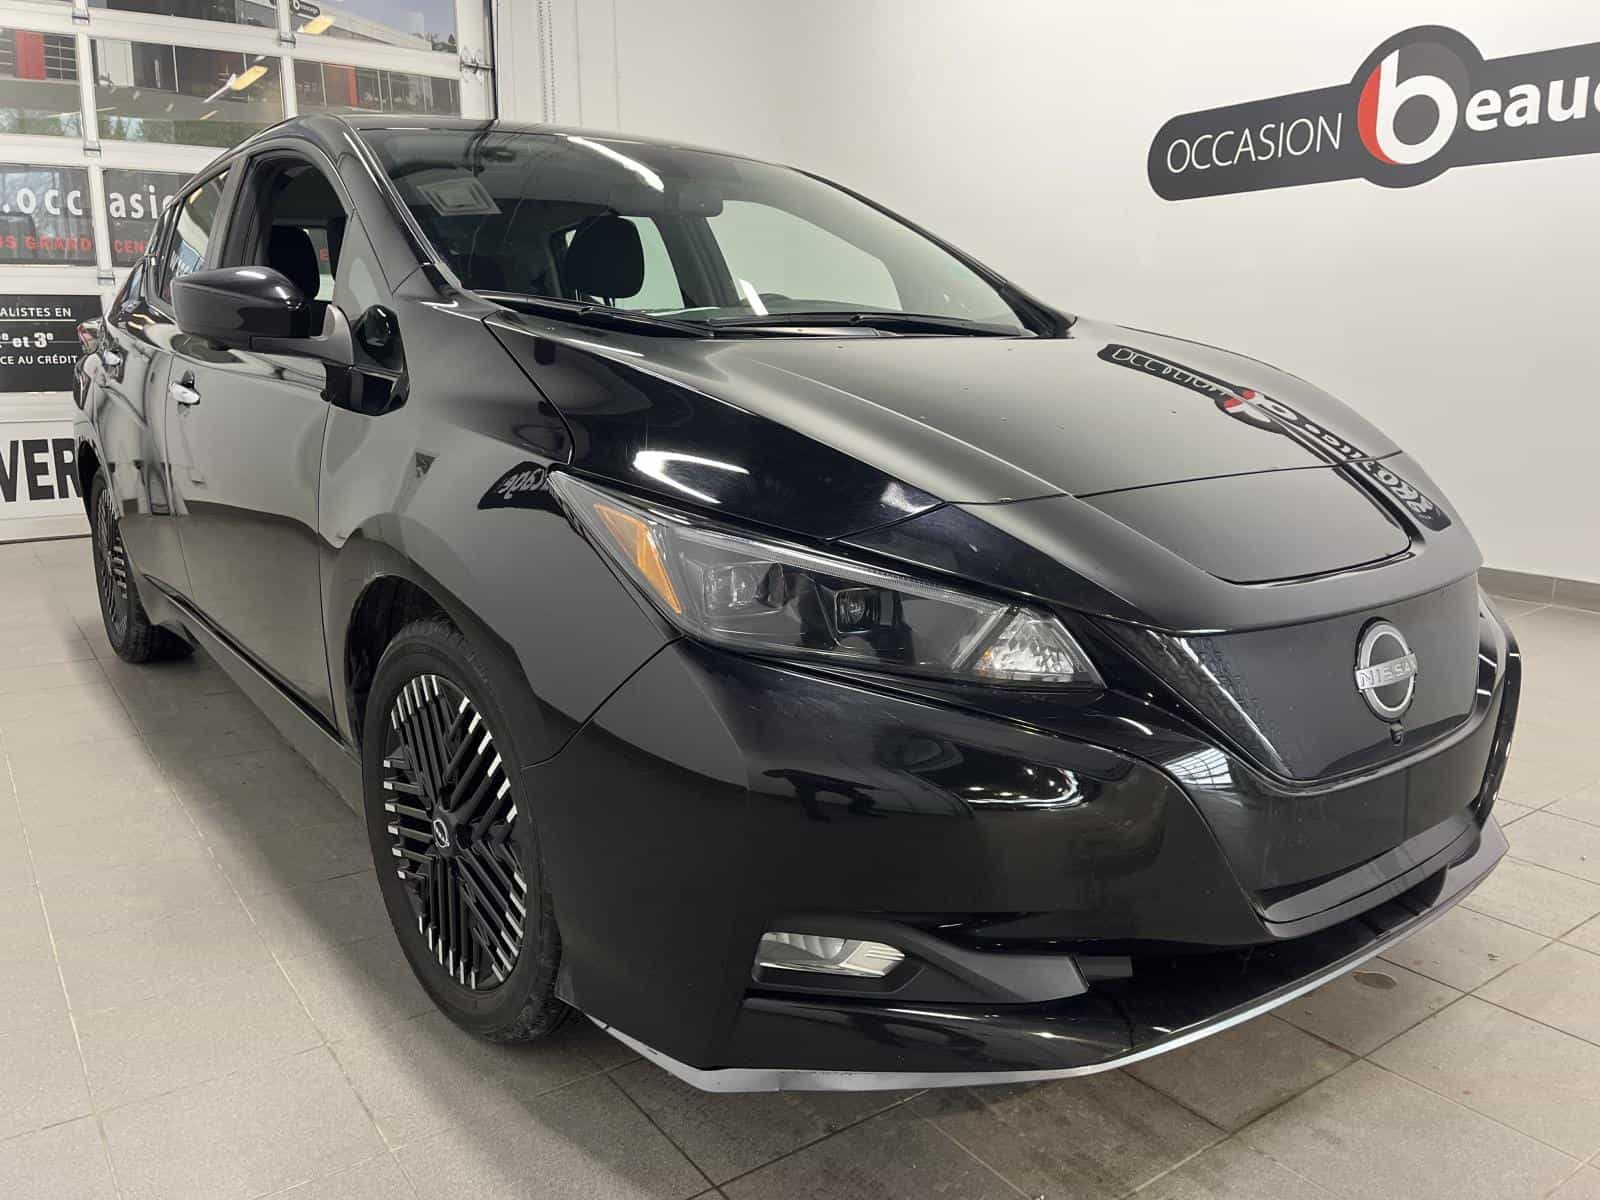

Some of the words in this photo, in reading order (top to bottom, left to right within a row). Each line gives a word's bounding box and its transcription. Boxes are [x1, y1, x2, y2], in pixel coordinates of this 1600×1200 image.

[1167, 112, 1343, 173] OCCASION
[1376, 49, 1600, 165] beau
[55, 307, 72, 318] EN
[12, 336, 30, 348] et
[18, 355, 33, 365] AU
[37, 353, 78, 365] CRÉDIT
